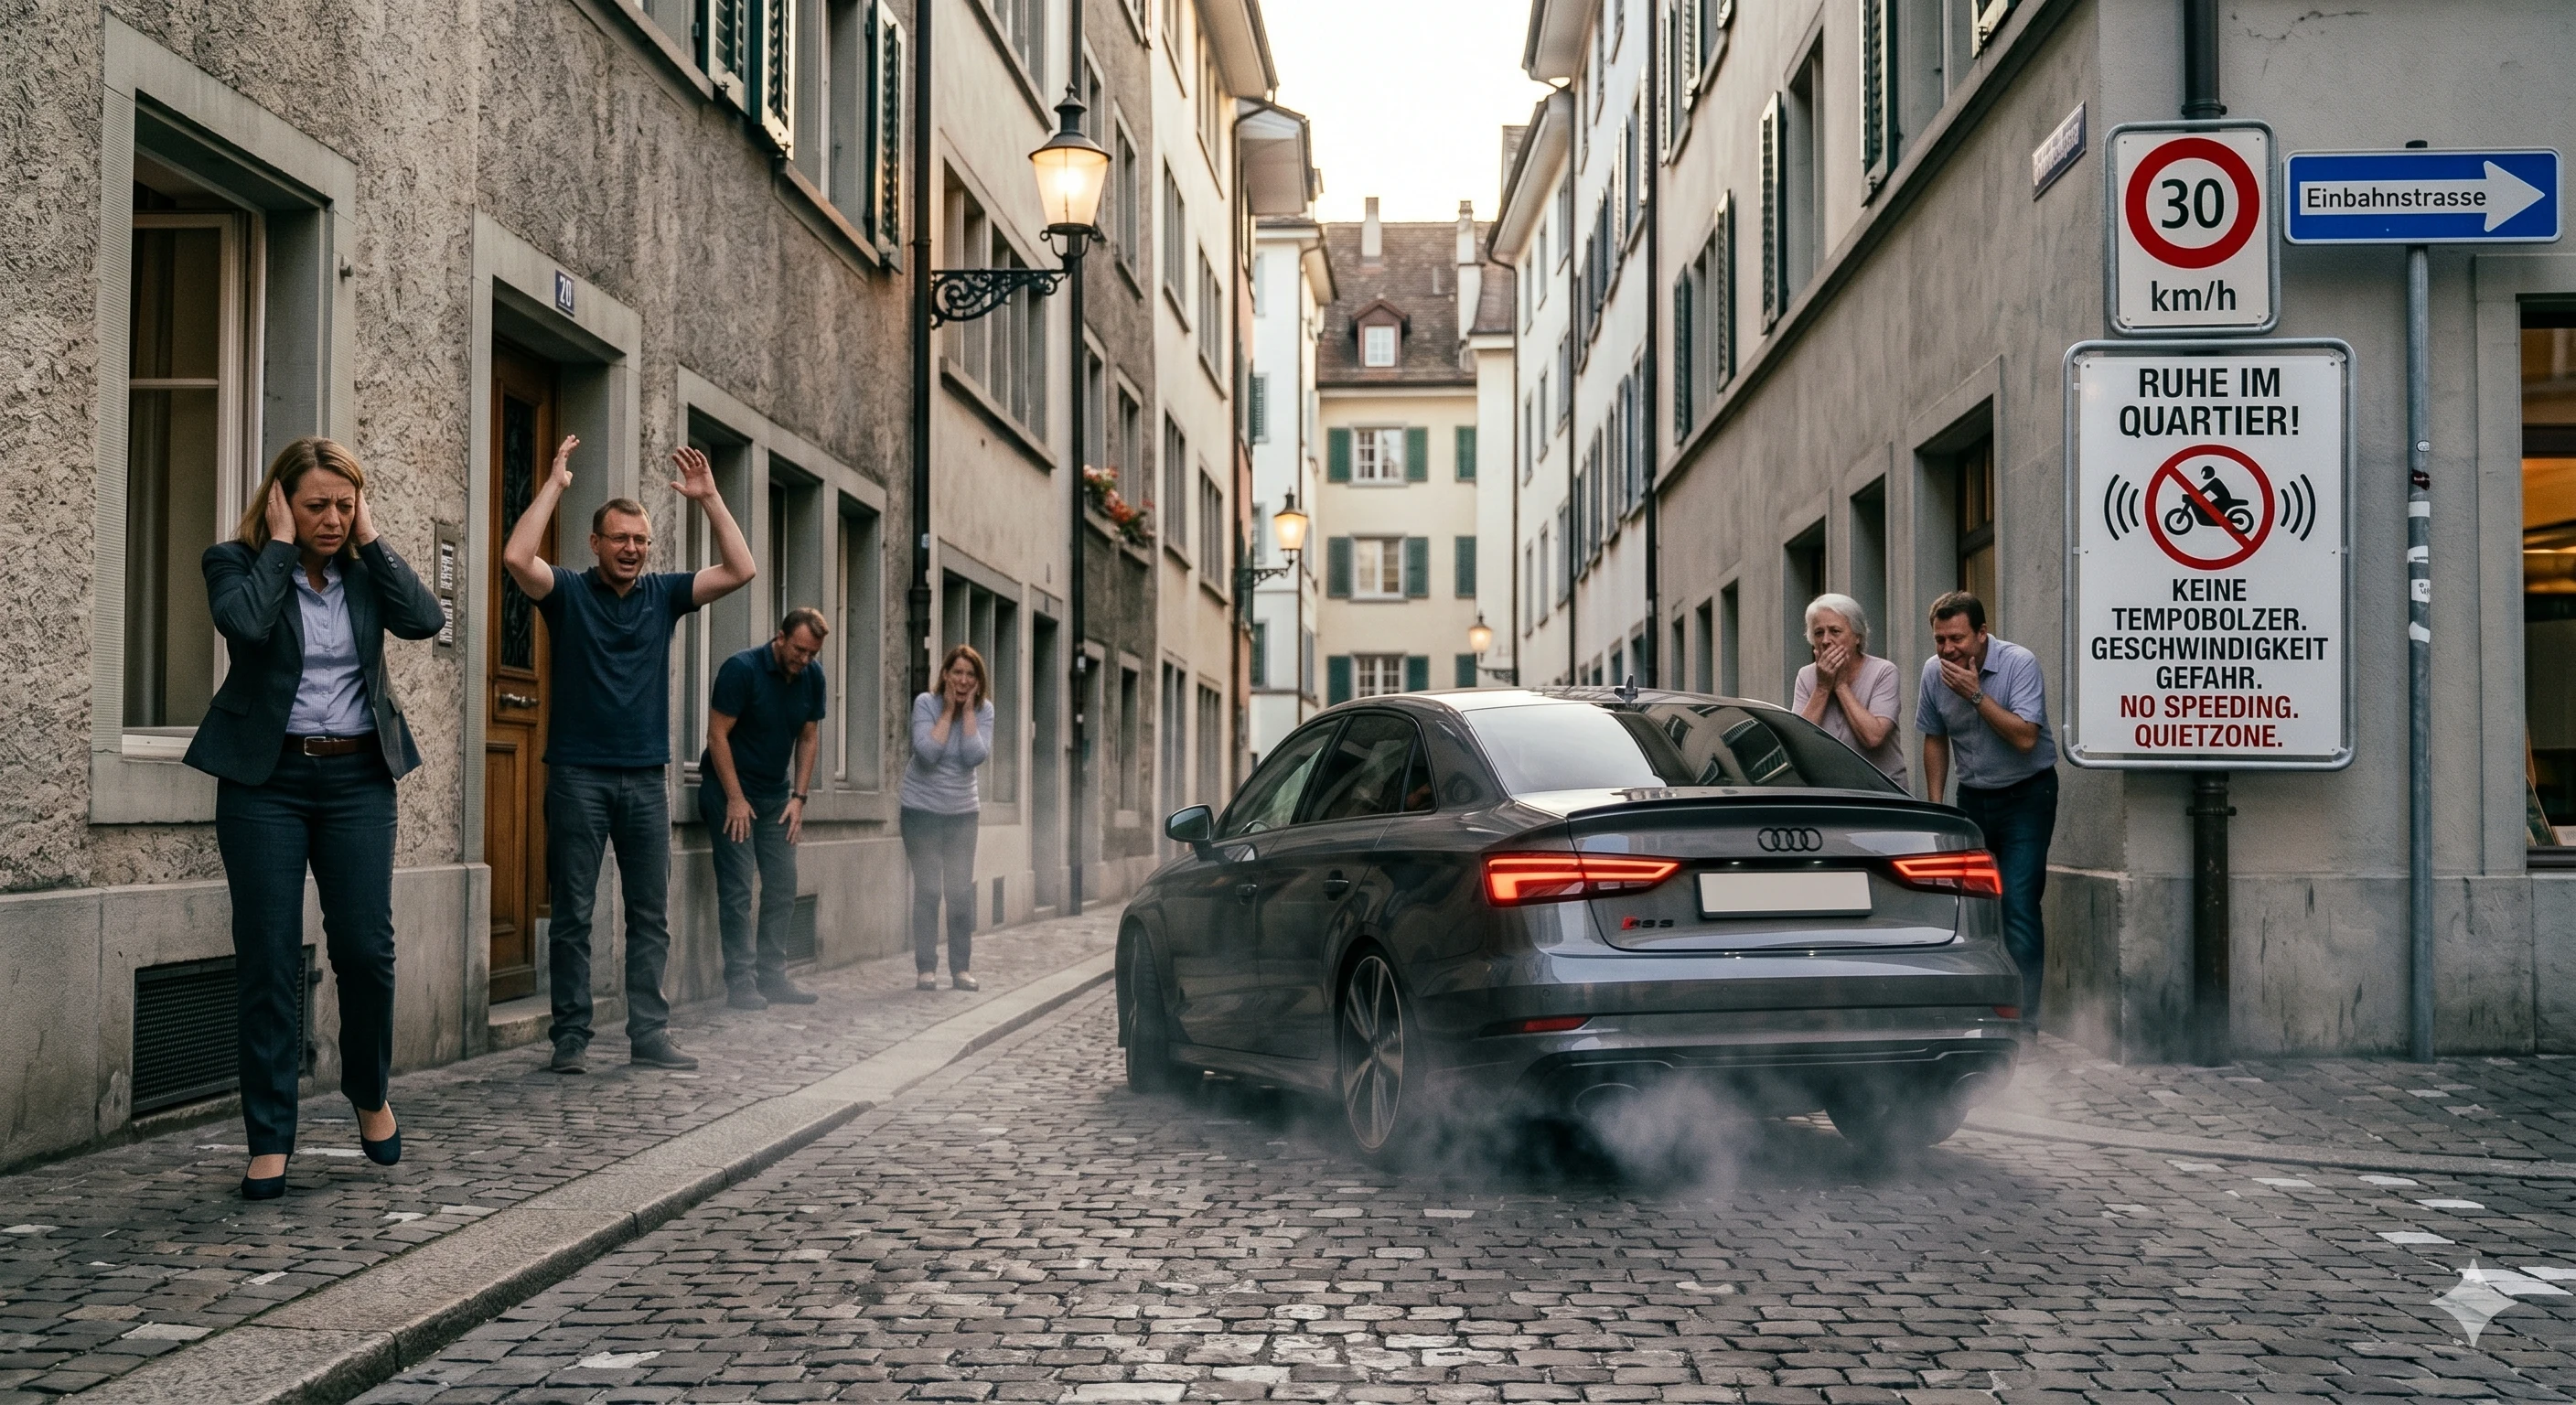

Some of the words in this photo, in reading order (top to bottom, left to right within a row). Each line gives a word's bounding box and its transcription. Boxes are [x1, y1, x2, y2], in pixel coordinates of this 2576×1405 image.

[2163, 178, 2225, 229] 30
[2307, 188, 2486, 208] Einbahnstrasse
[560, 275, 571, 306] 20
[2152, 280, 2237, 311] km/h
[2139, 368, 2228, 398] RUHE
[2242, 368, 2281, 397] IM
[2119, 406, 2299, 438] QUARTIER!
[2173, 579, 2247, 601] KEINE
[2112, 608, 2307, 631] TEMPOBOLZER.
[2091, 637, 2329, 660] GESCHWINDIGKEIT
[2156, 666, 2262, 689] GEFAHR.
[2120, 695, 2156, 718] NO
[2164, 695, 2299, 718] SPEEDING.
[2134, 724, 2283, 748] QUIETZONE.
